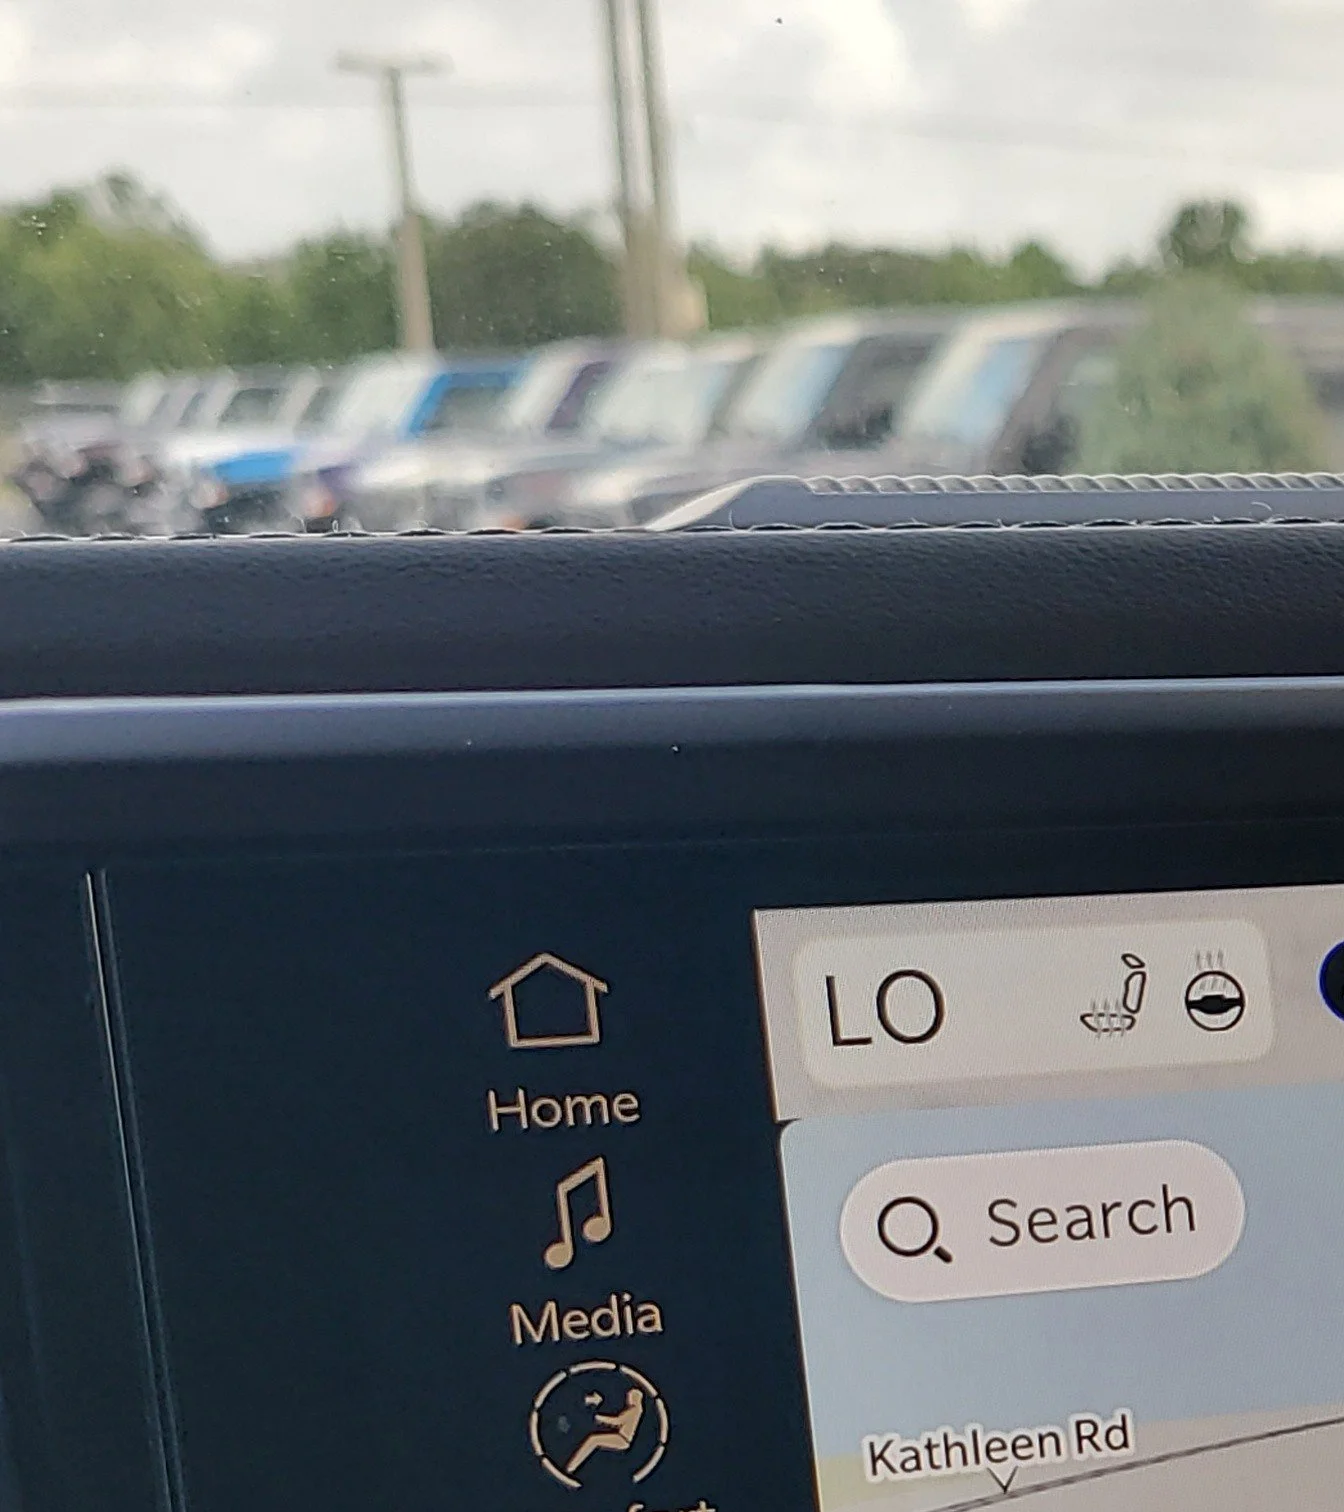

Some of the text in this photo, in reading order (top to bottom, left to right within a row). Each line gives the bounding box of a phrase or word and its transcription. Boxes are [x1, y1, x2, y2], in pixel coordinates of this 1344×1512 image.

[824, 967, 946, 1047] LO
[485, 1088, 641, 1132] Home
[985, 1184, 1198, 1249] Search
[509, 1294, 664, 1344] Media
[868, 1415, 1132, 1478] Kathleen Rd
